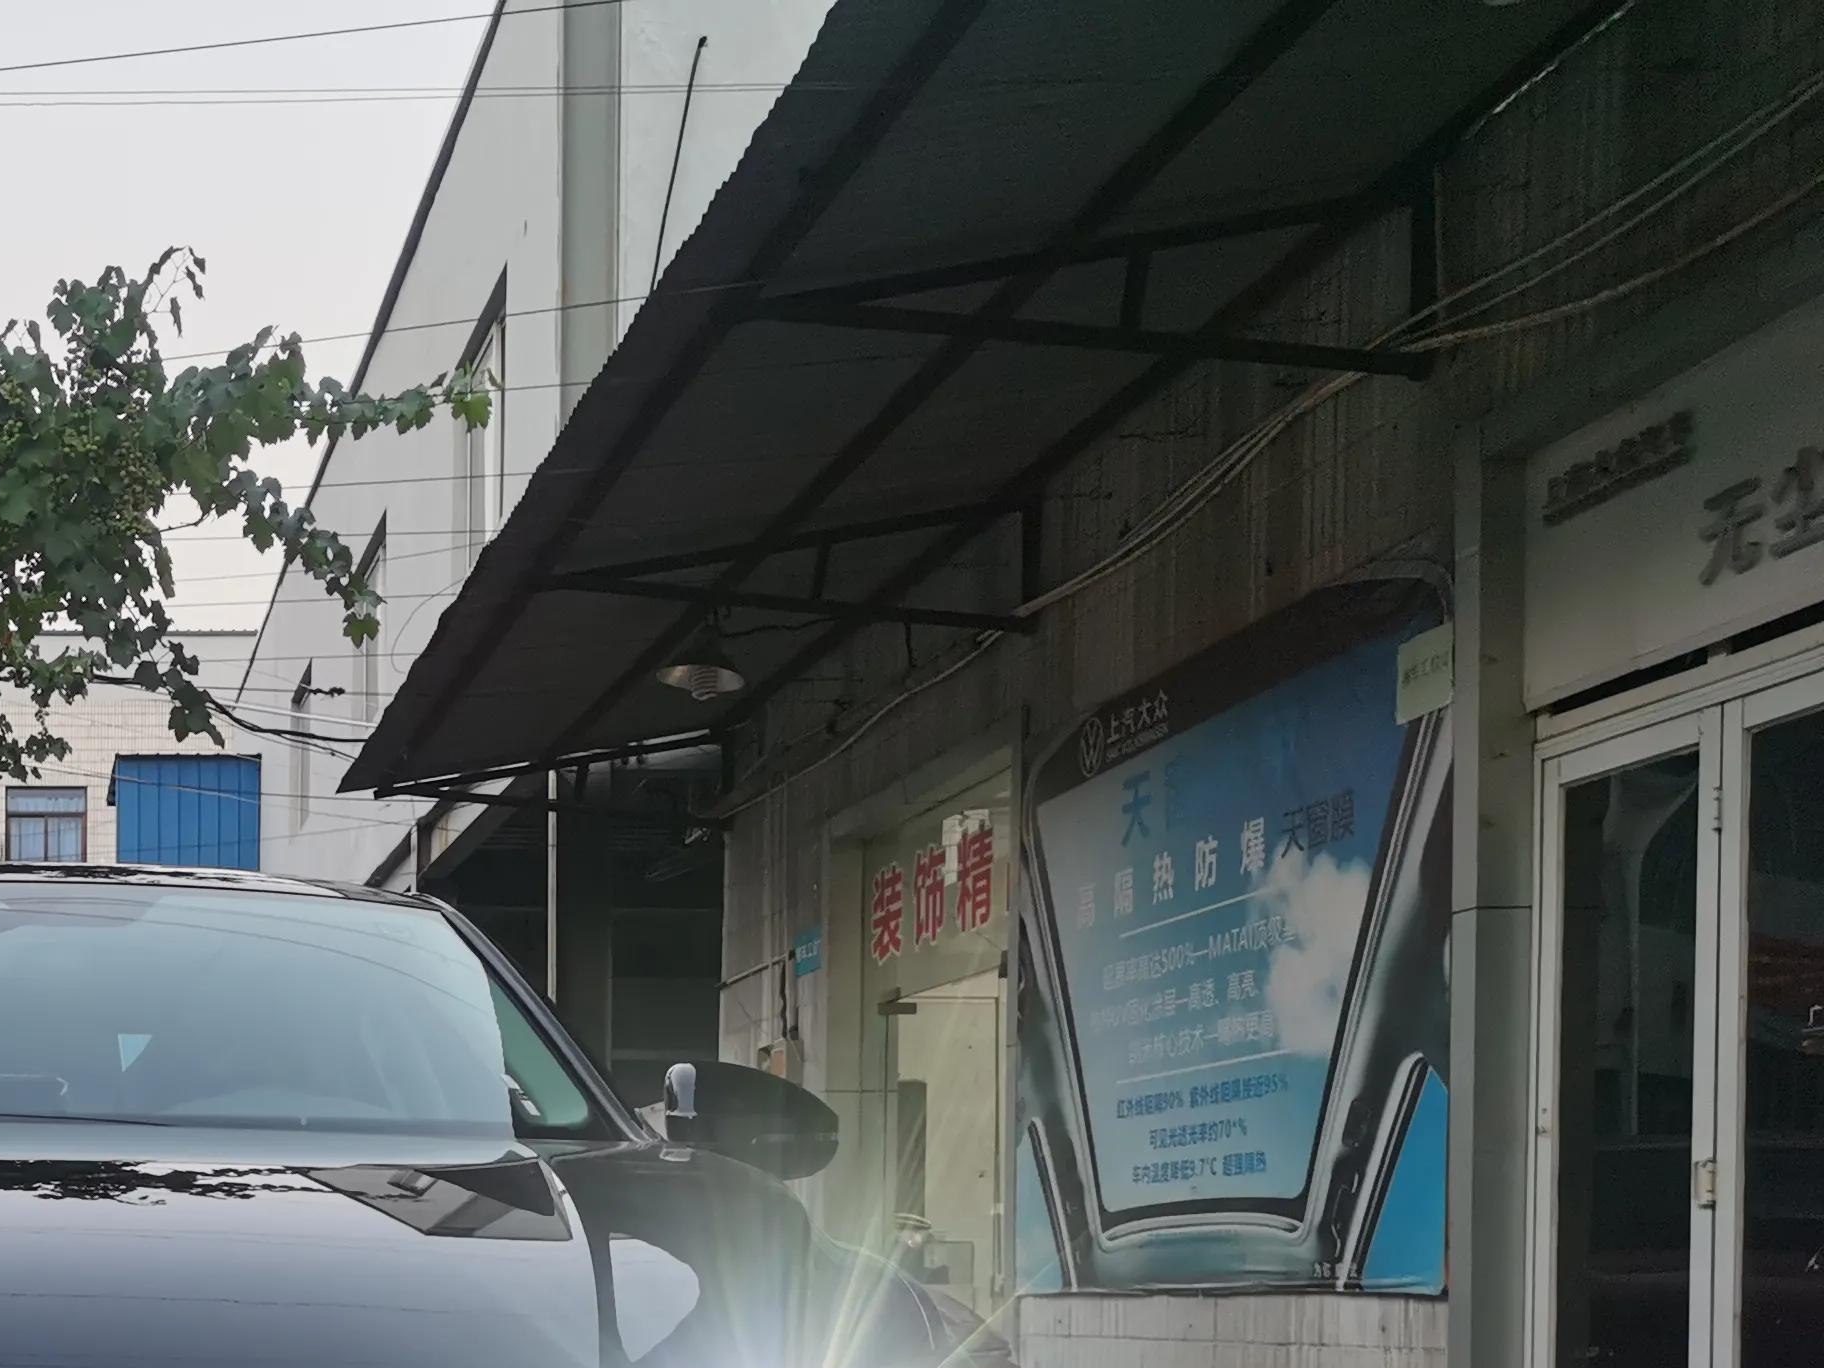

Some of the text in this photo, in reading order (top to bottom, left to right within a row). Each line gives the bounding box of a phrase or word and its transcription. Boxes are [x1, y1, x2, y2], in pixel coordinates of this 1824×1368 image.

[1104, 688, 1170, 744] 上汽大众
[871, 819, 1010, 966] 装饰精
